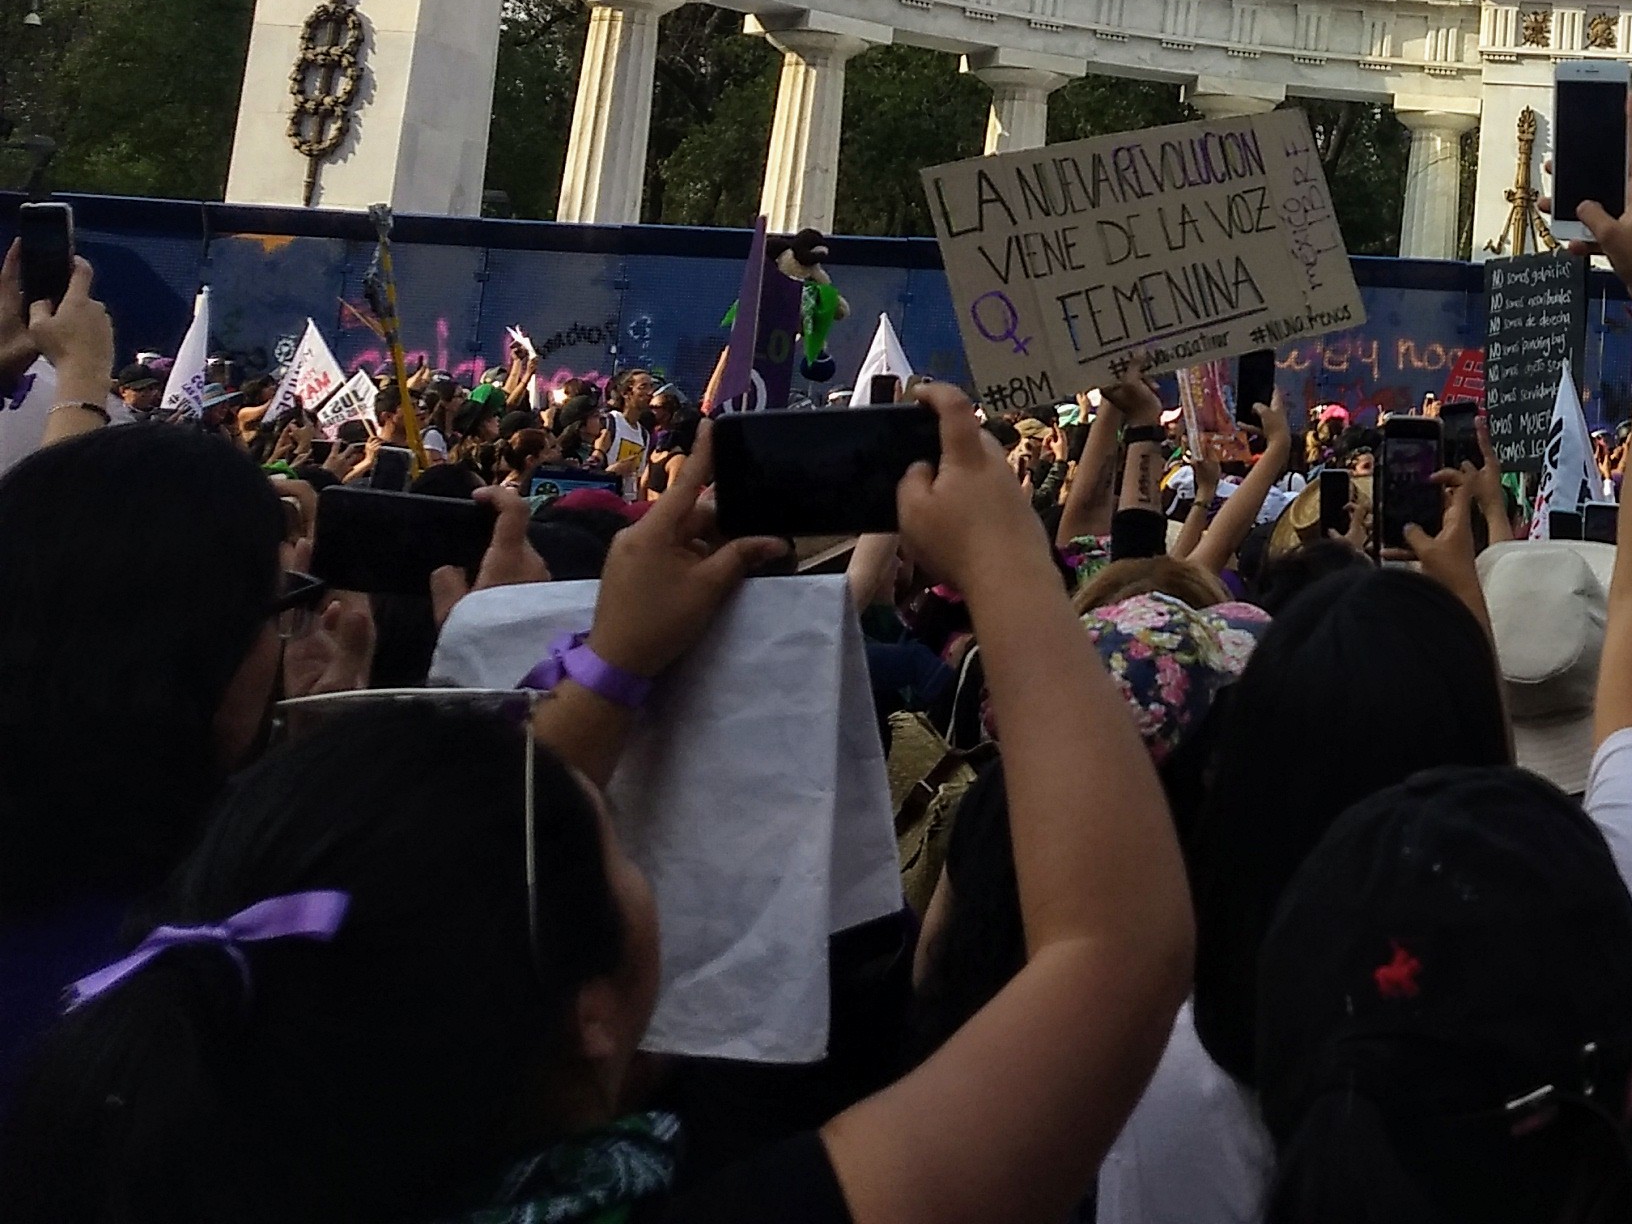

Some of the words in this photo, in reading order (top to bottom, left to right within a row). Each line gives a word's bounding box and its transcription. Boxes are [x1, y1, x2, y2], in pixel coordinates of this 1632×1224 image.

[934, 169, 1017, 238] LA
[1016, 152, 1120, 220] NUEVA
[1111, 128, 1266, 204] REVOLUCION
[977, 227, 1085, 285] VIENE
[1097, 214, 1151, 266] DE
[1158, 203, 1204, 251] LA
[1204, 186, 1276, 240] VOZ
[1492, 268, 1504, 288] NO
[1056, 256, 1265, 352] FEMENINA
[1490, 292, 1504, 311] NO
[1488, 316, 1501, 335] NO
[1525, 313, 1536, 328] de
[1488, 342, 1502, 360] NO
[982, 371, 1055, 413] #8M
[1487, 388, 1499, 408] NO
